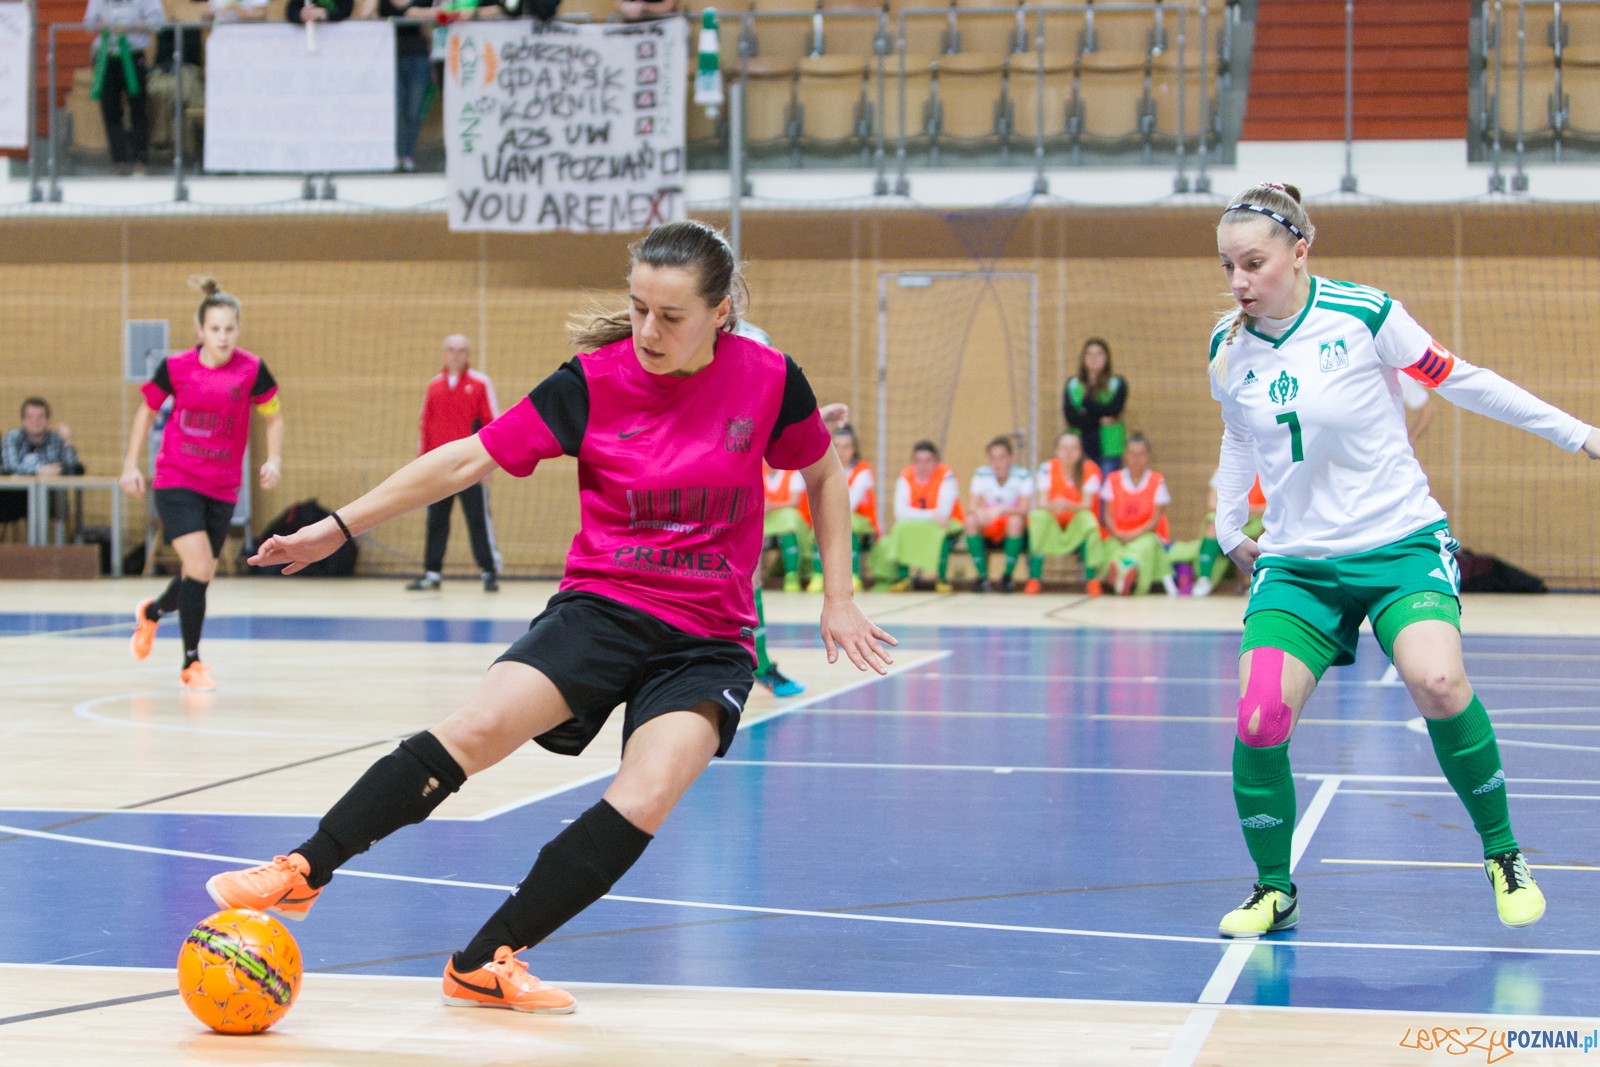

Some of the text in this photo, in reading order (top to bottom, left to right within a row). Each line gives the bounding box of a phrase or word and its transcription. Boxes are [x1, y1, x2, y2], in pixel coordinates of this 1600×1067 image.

[501, 122, 612, 151] AZS UW
[482, 152, 545, 185] UAM
[458, 186, 684, 228] YOU ARE NEXT
[1275, 411, 1304, 463] 7
[613, 545, 732, 572] PRIMEX
[613, 560, 733, 579] TRANSPORT OSOBOWY
